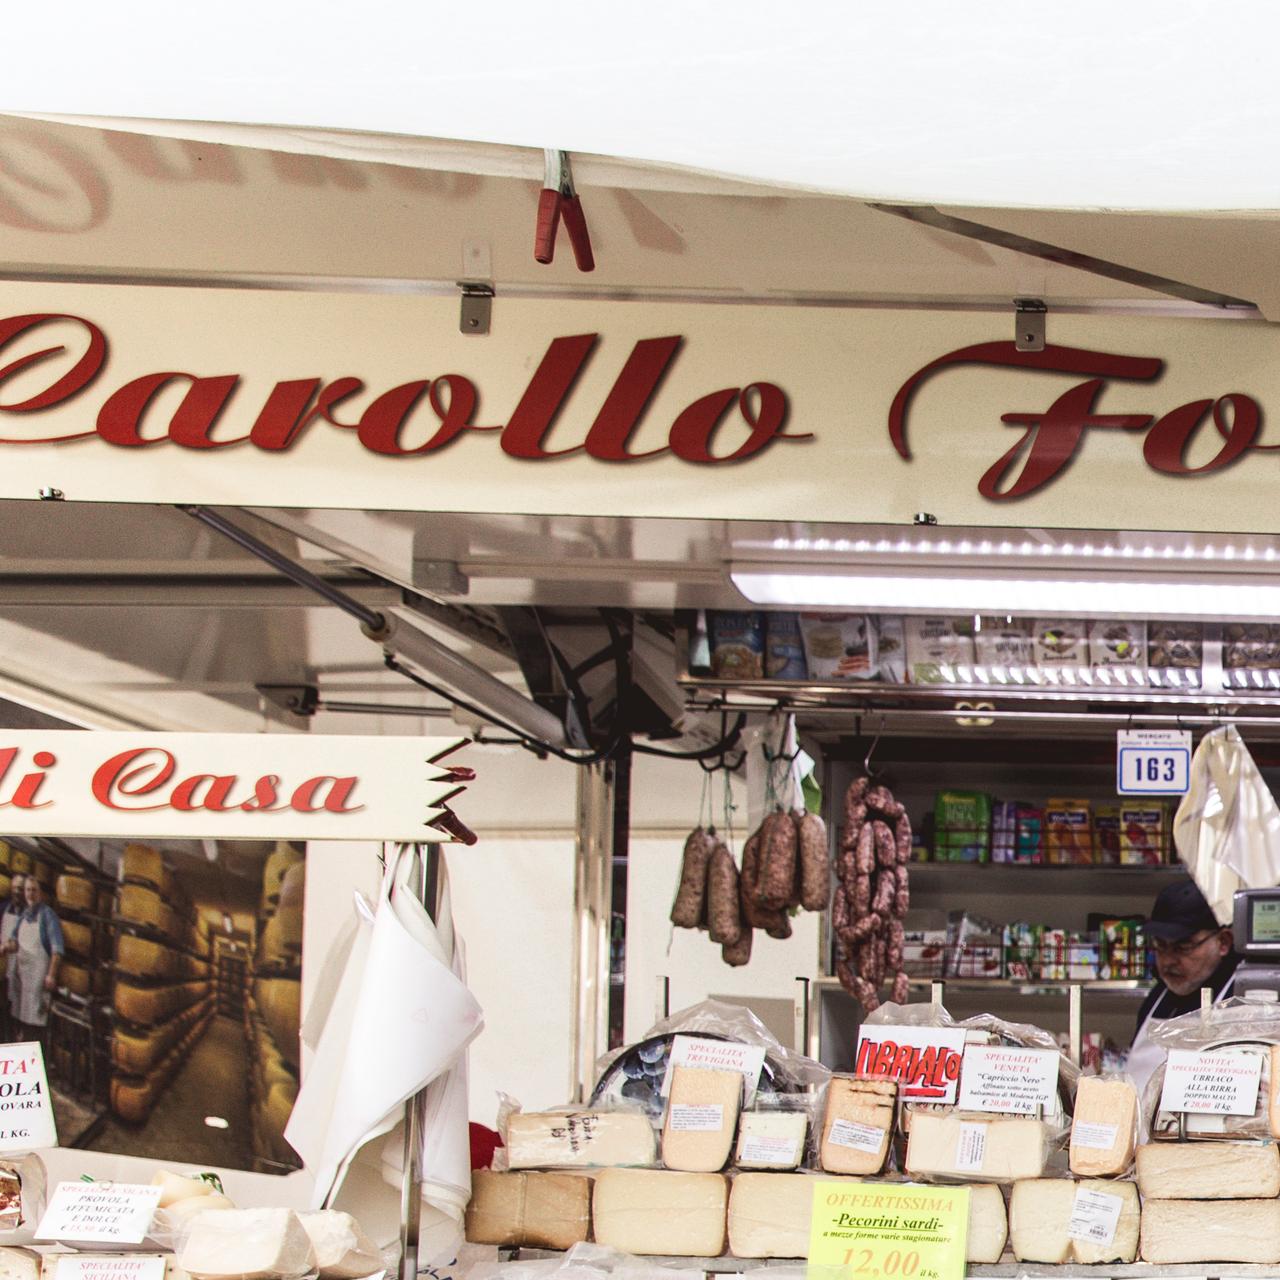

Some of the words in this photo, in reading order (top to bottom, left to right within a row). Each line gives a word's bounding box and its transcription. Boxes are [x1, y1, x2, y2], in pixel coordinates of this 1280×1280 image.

[0, 313, 815, 466] Carollo
[91, 747, 366, 813] Casa
[1135, 757, 1175, 782] 163
[984, 1053, 1042, 1063] SPECIALITA'
[993, 1064, 1031, 1074] VENETA
[826, 1192, 953, 1212] OFFERTISSIMA
